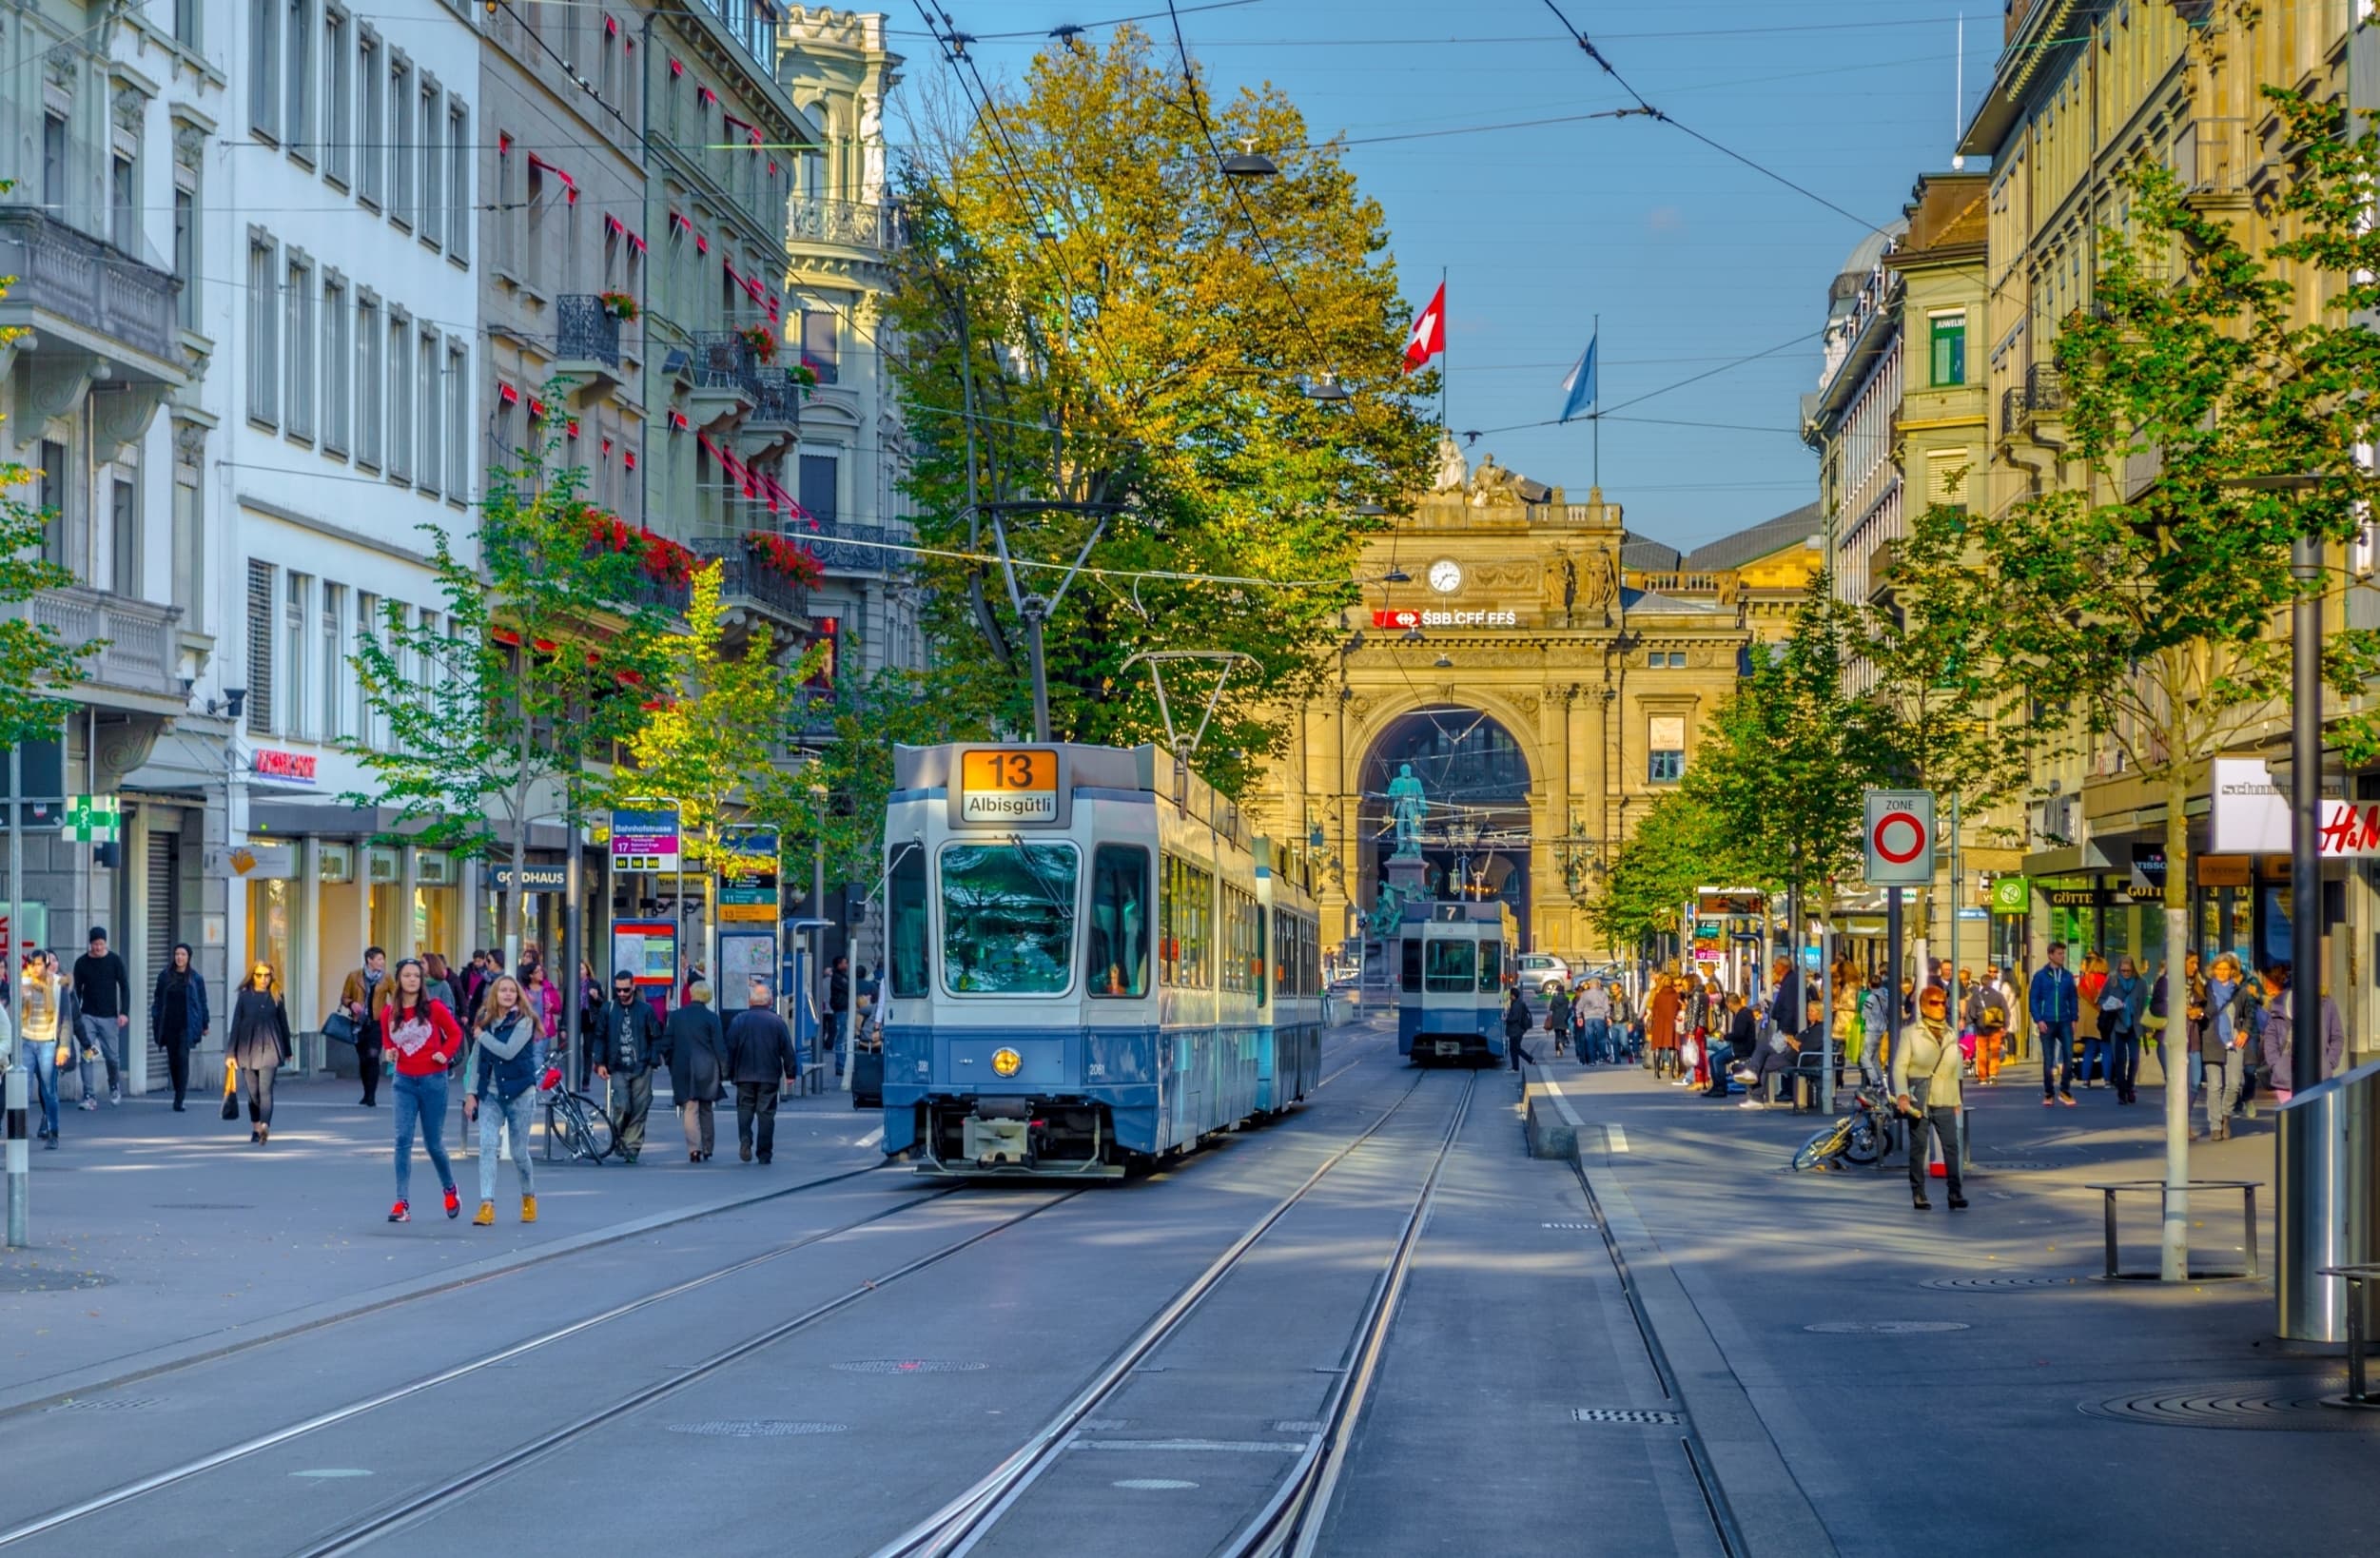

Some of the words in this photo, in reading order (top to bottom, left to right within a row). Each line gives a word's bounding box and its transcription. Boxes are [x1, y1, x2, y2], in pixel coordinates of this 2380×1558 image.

[1422, 610, 1452, 625] SBB
[1455, 610, 1485, 625] CFF
[1488, 610, 1516, 625] FFS
[988, 754, 1033, 788] 13
[969, 797, 1051, 815] Albisgütli
[1886, 800, 1914, 809] ZONE
[2318, 805, 2380, 853] H&M
[617, 843, 629, 852] 17
[2136, 861, 2167, 869] TISSO
[497, 871, 564, 884] GODHAUS
[725, 895, 734, 904] 11
[2053, 891, 2093, 904] GÖTTE
[1446, 906, 1456, 921] 7
[1089, 1063, 1104, 1075] 2061
